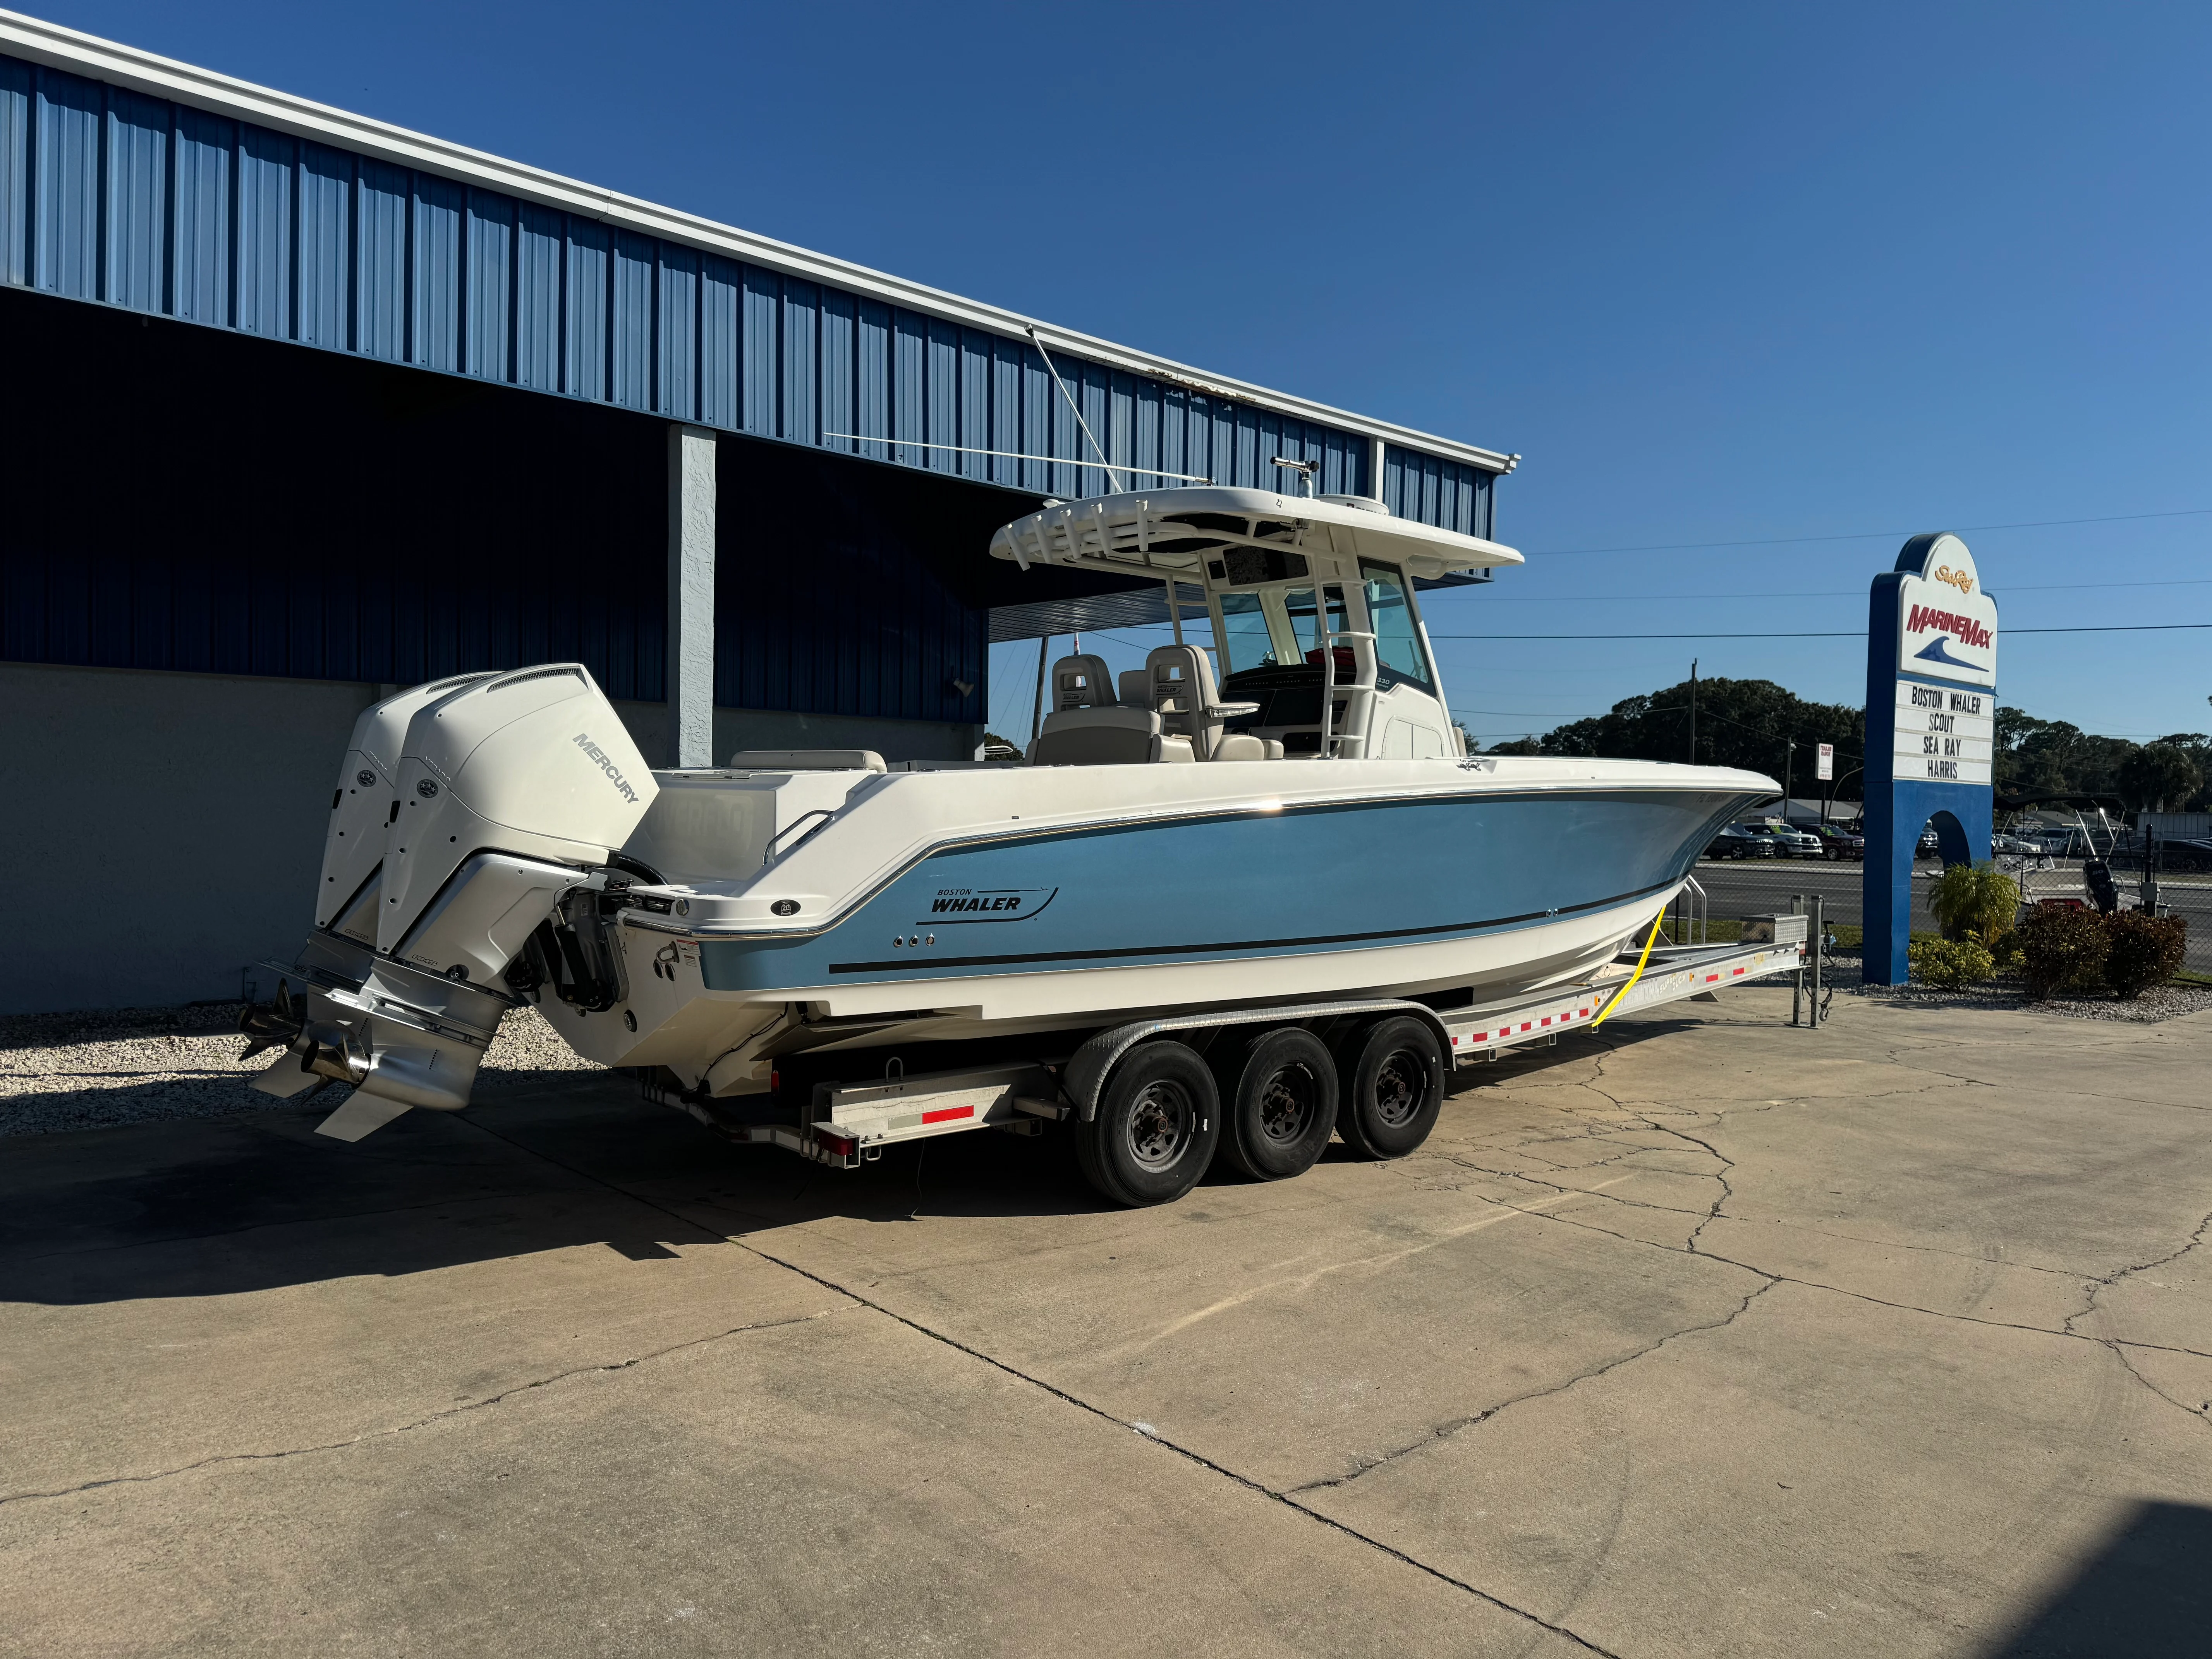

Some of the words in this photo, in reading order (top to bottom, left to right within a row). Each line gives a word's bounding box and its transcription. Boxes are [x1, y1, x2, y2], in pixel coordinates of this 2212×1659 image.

[1912, 686, 1943, 709] BOSTON
[1950, 693, 1981, 714] WHALER
[1929, 713, 1954, 733] SCOUT
[1923, 736, 1939, 754] SEA
[1944, 738, 1961, 757] RAY
[572, 733, 639, 804] MERCURY
[1928, 759, 1957, 779] HARRIS
[931, 897, 1021, 912] WHALER
